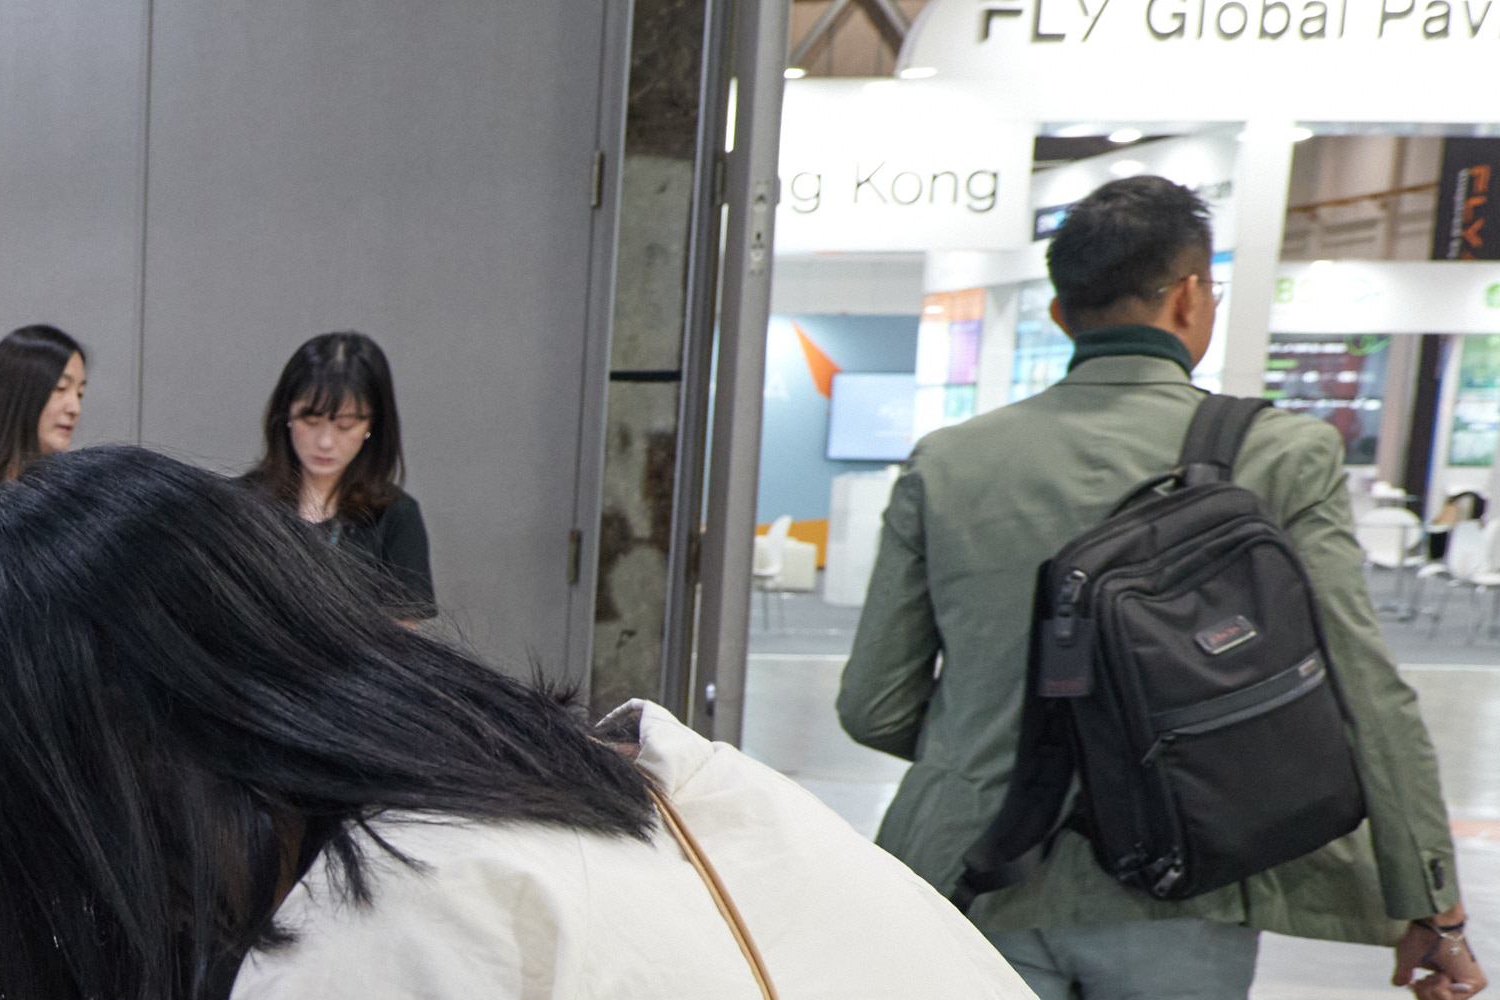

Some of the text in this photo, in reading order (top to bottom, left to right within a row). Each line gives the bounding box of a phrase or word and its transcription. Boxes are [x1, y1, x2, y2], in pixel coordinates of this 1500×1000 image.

[978, 0, 1500, 42] FLY Global Pav
[853, 161, 998, 213] Kong
